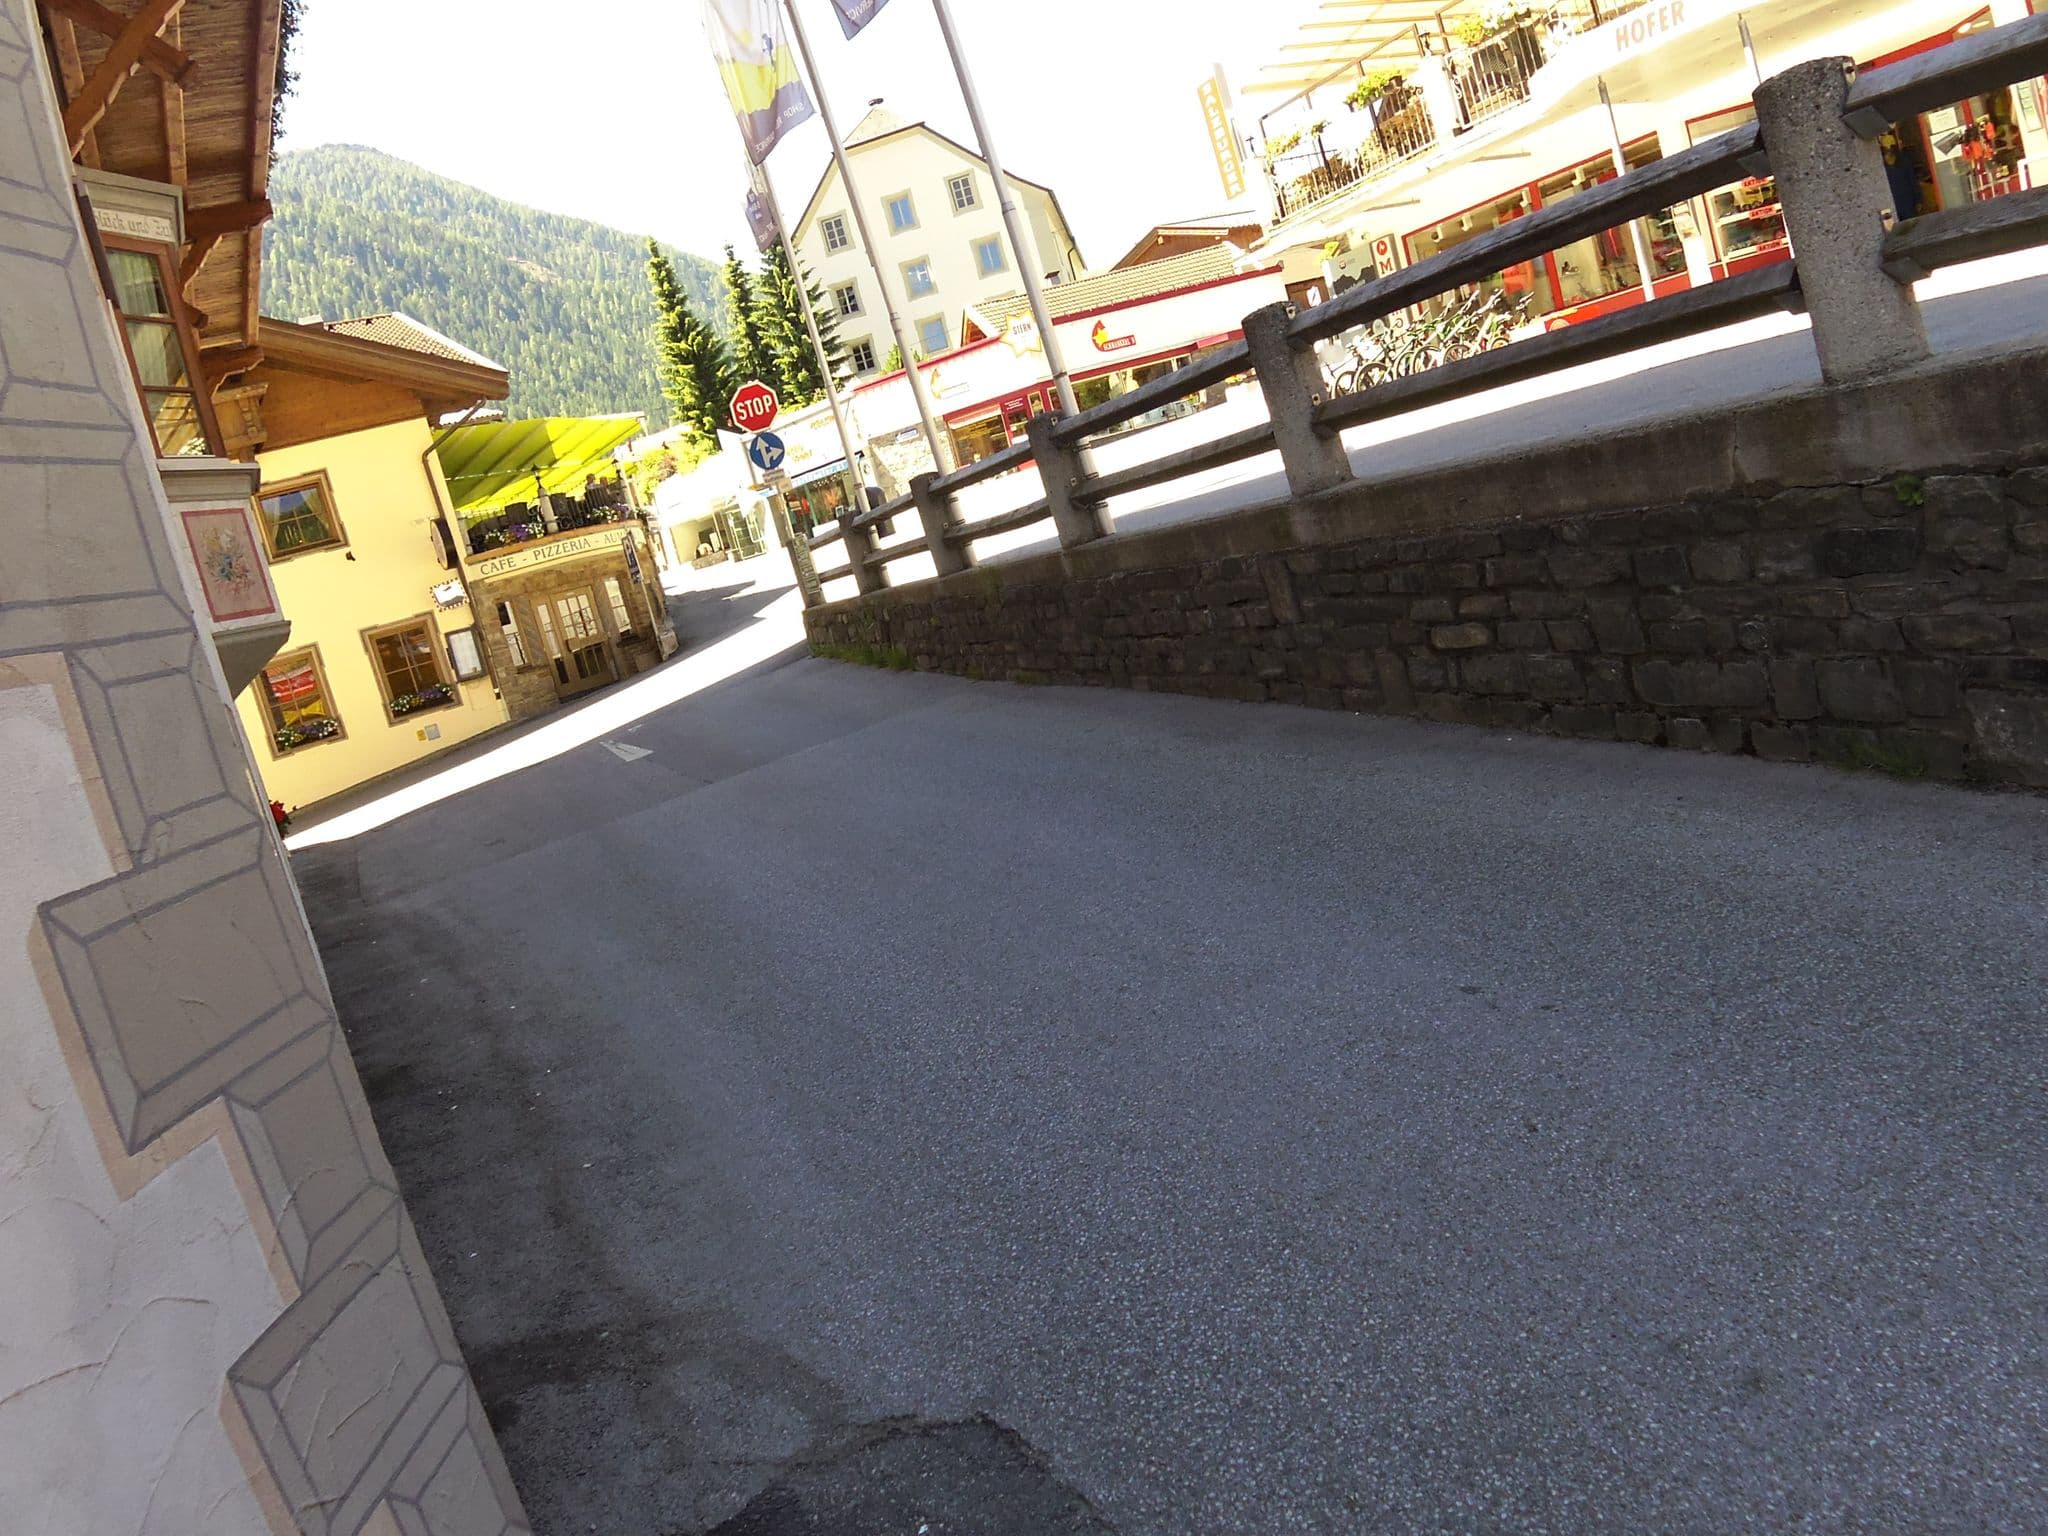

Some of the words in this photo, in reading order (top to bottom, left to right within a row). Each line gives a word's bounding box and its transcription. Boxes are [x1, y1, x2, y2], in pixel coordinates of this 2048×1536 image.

[1616, 1, 1684, 51] HOFER
[736, 394, 773, 420] STOP
[480, 556, 516, 575] CAFE
[533, 538, 591, 561] PIZZERIA
